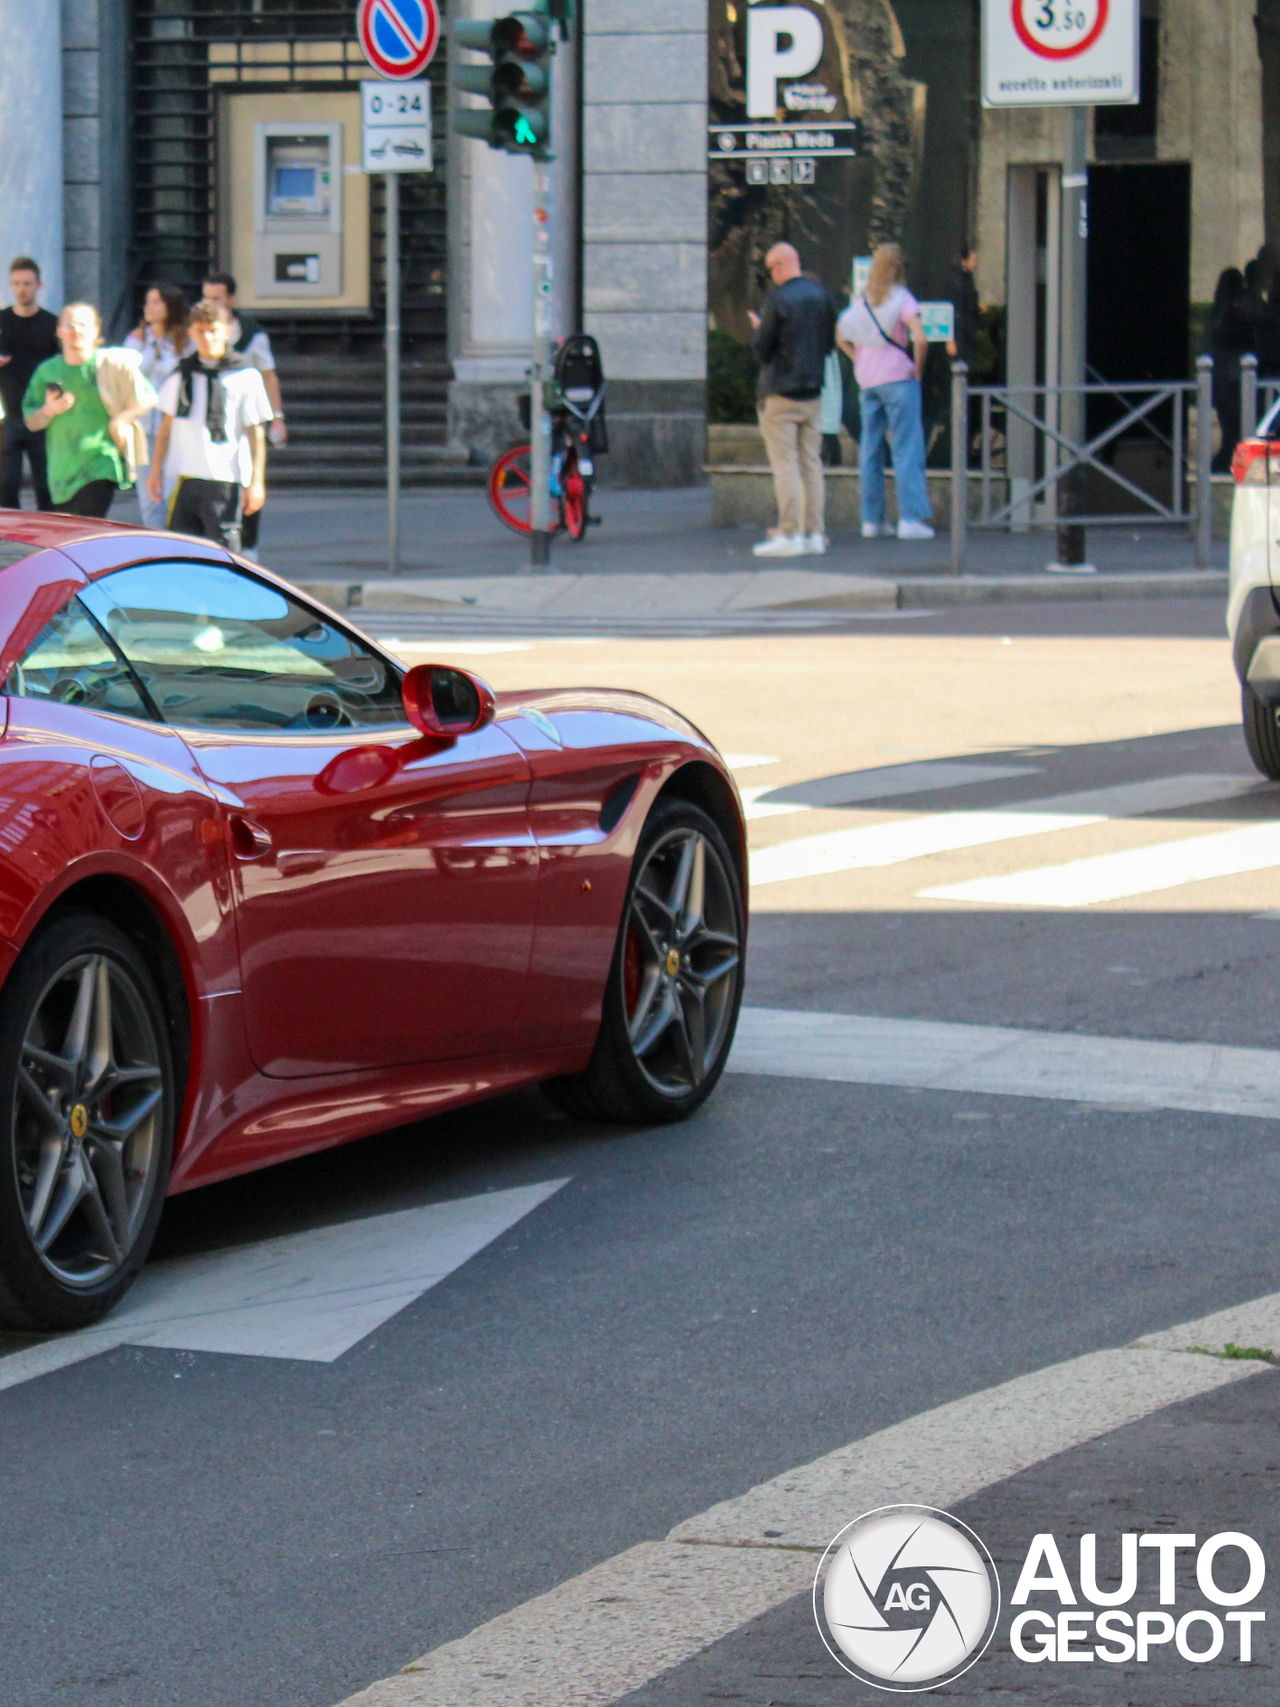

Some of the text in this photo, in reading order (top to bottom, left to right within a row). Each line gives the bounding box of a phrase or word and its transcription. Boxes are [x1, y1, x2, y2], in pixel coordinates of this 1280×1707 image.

[747, 5, 824, 118] P
[746, 131, 835, 150] Piazza Meda
